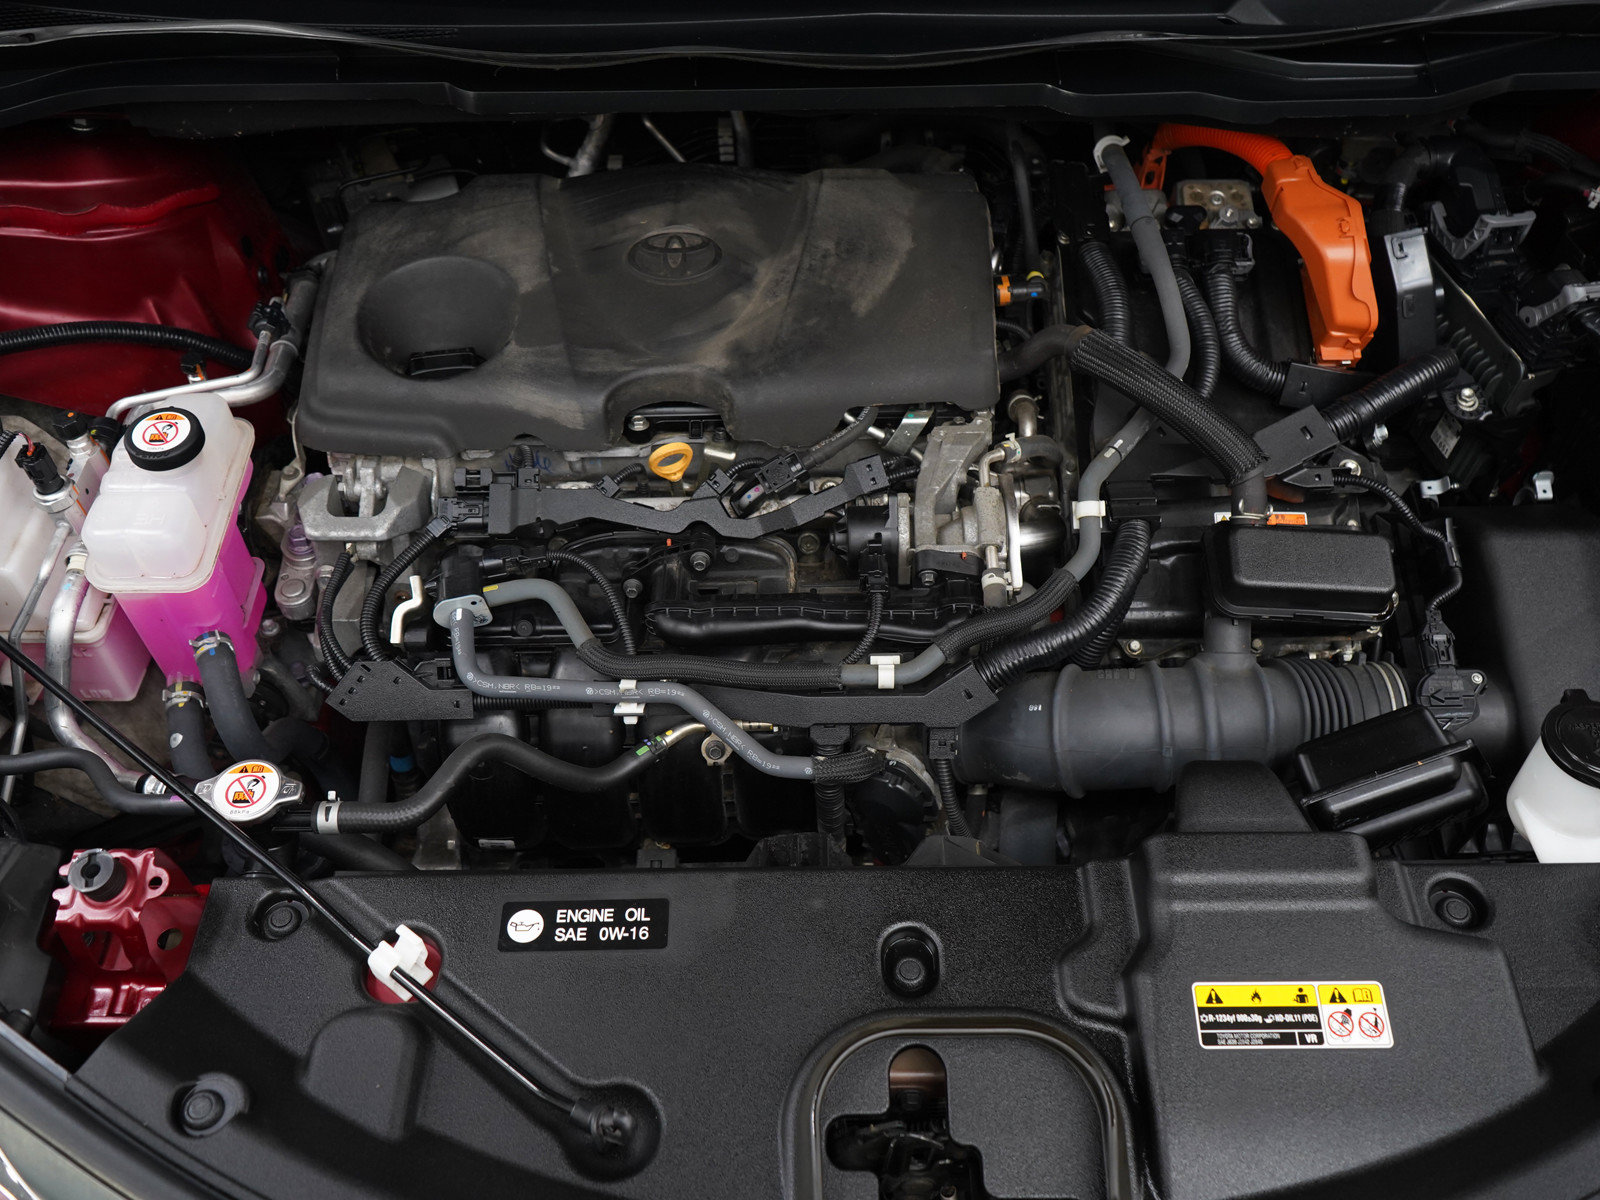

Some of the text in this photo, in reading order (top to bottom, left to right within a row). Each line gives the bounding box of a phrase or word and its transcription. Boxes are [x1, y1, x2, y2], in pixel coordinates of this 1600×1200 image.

[556, 907, 651, 923] ENGINE OIL
[554, 926, 650, 942] SAE 0W-16
[1303, 1034, 1319, 1044] VR
